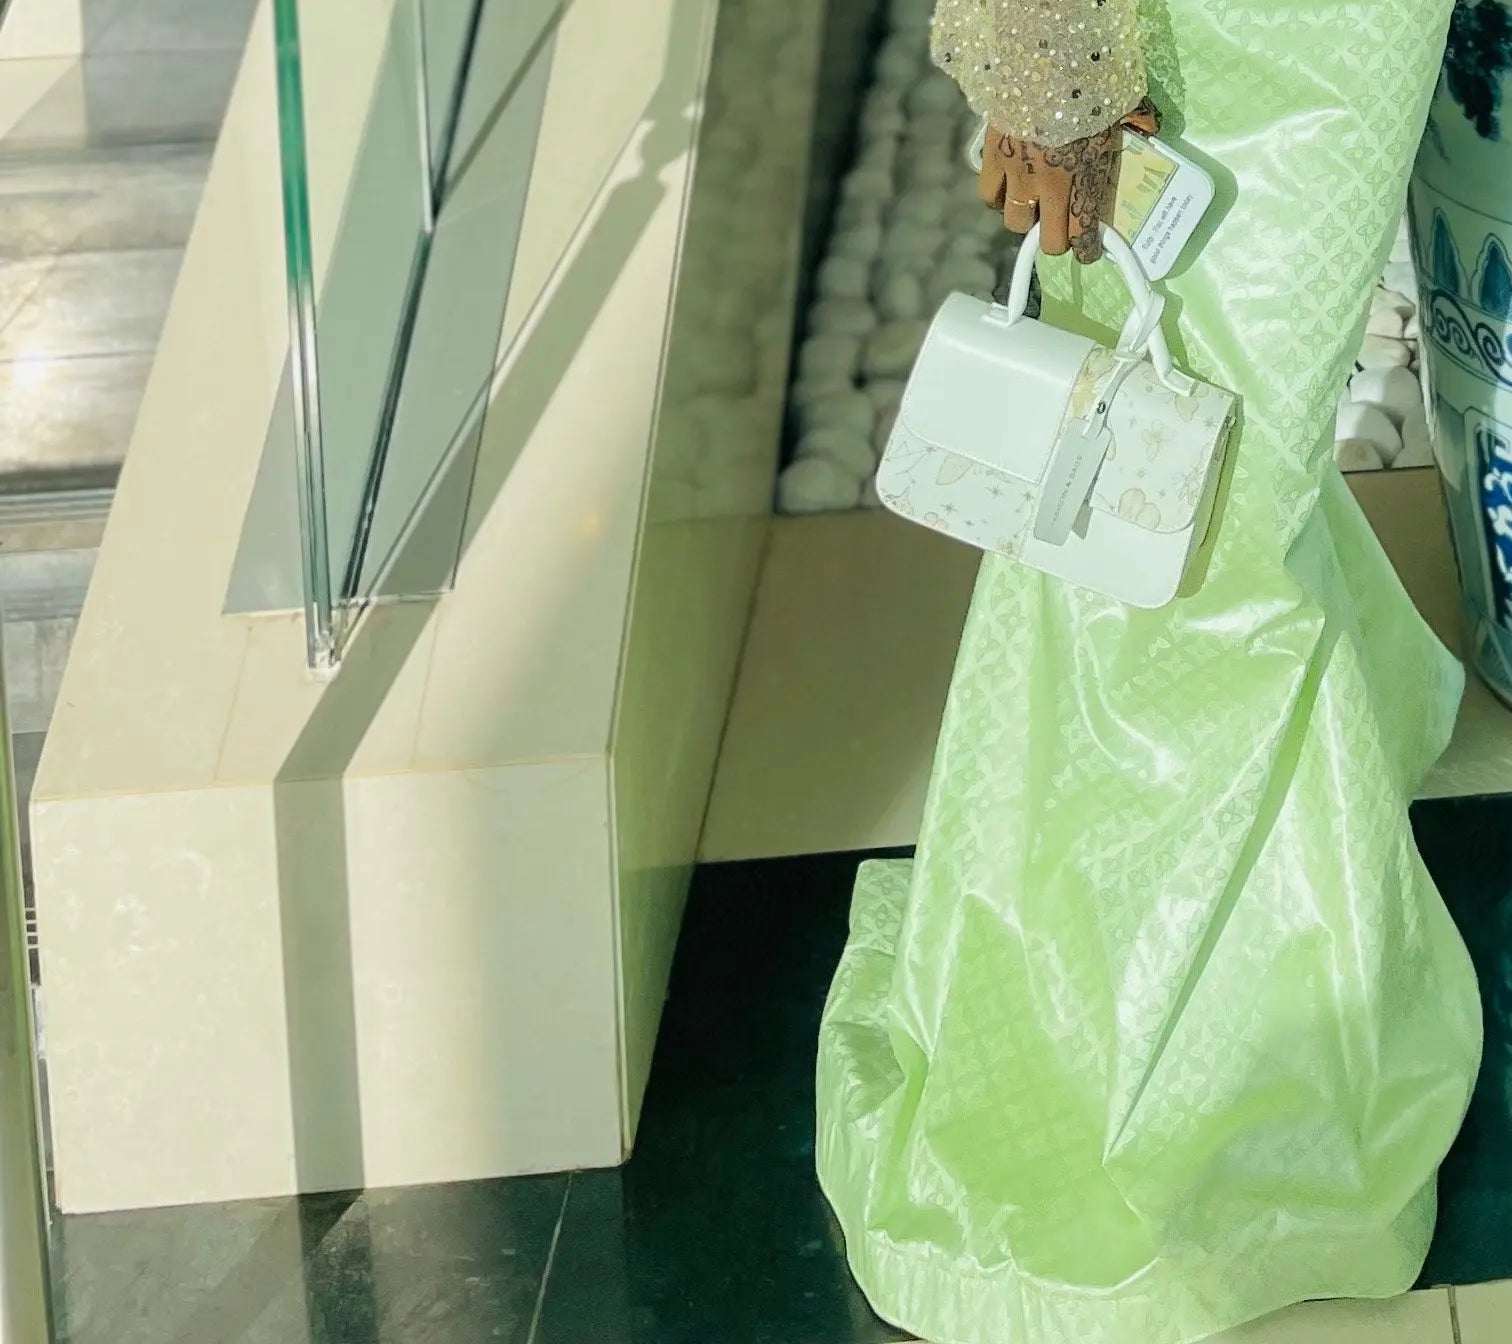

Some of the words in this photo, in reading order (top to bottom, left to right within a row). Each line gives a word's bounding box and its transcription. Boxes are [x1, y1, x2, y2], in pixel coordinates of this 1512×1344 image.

[1165, 195, 1178, 210] have
[1157, 231, 1172, 249] things
[1167, 208, 1182, 231] happen
